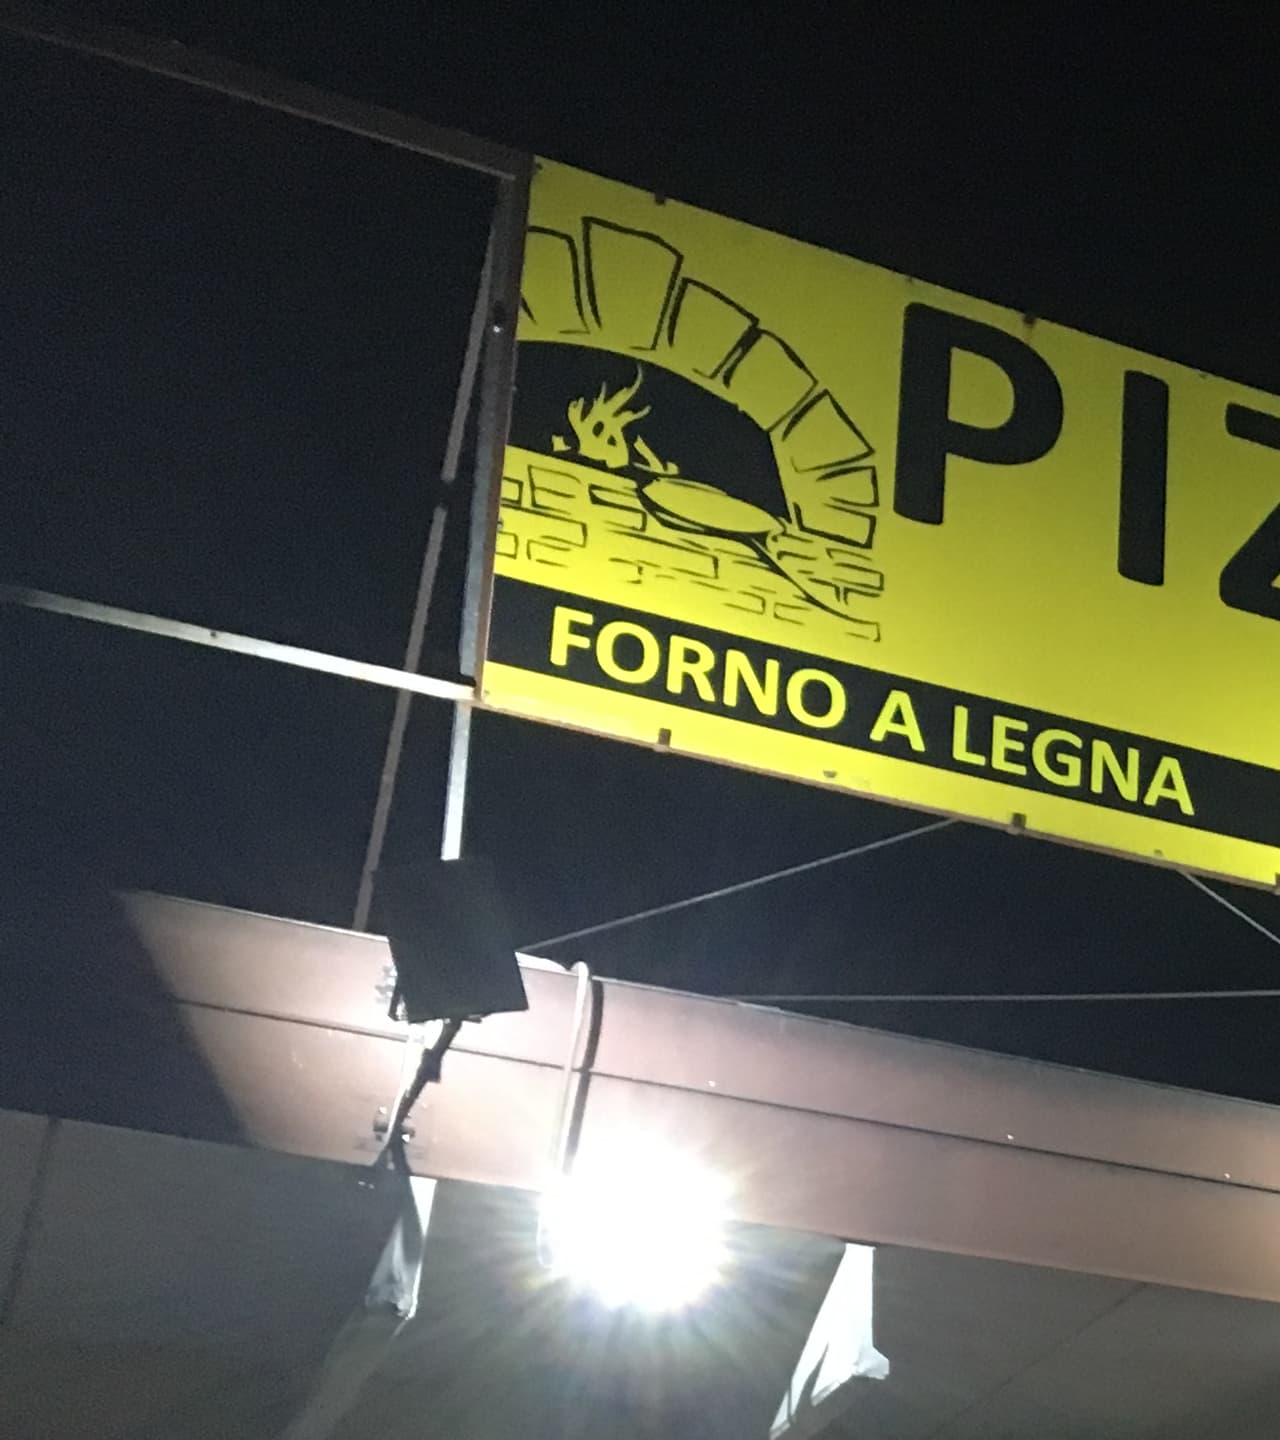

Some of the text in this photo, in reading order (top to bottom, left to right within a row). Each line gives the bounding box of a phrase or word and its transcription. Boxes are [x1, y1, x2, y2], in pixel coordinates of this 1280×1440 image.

[549, 605, 1195, 816] FORNO A LEGNA
